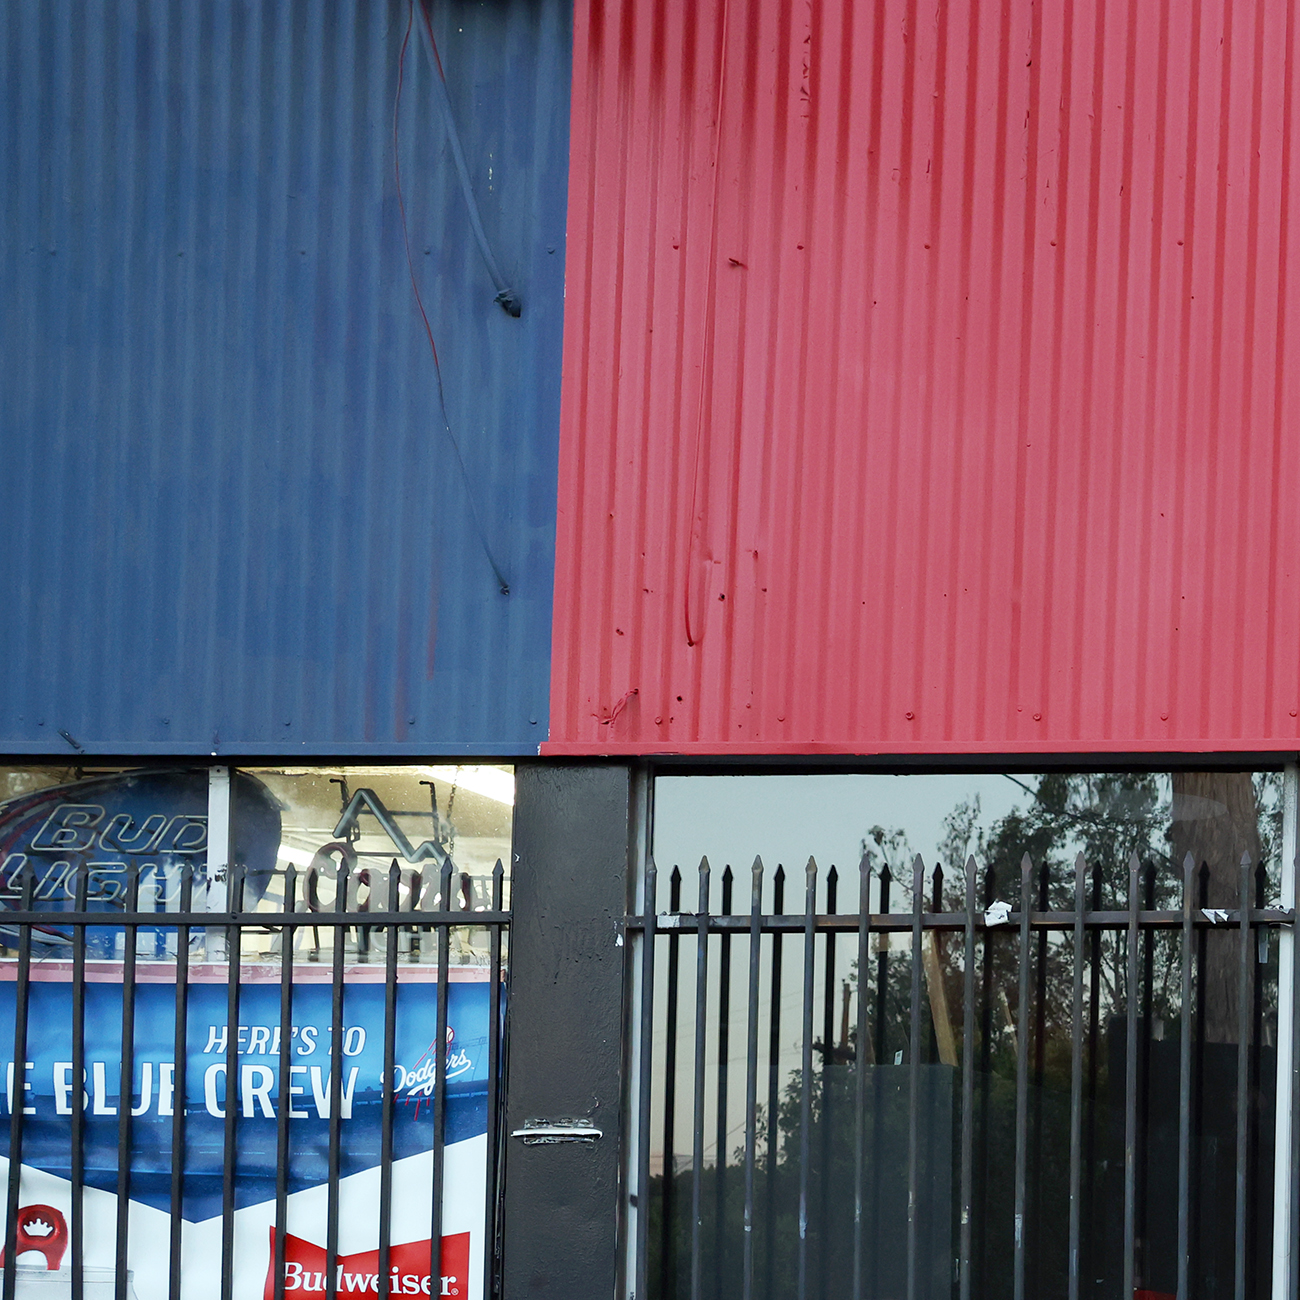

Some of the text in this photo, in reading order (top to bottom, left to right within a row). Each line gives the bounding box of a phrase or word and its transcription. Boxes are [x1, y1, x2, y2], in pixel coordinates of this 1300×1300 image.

[0, 853, 214, 902] LIGH
[0, 1062, 359, 1120] E BLUE CREW
[284, 1261, 458, 1297] Budweiser
